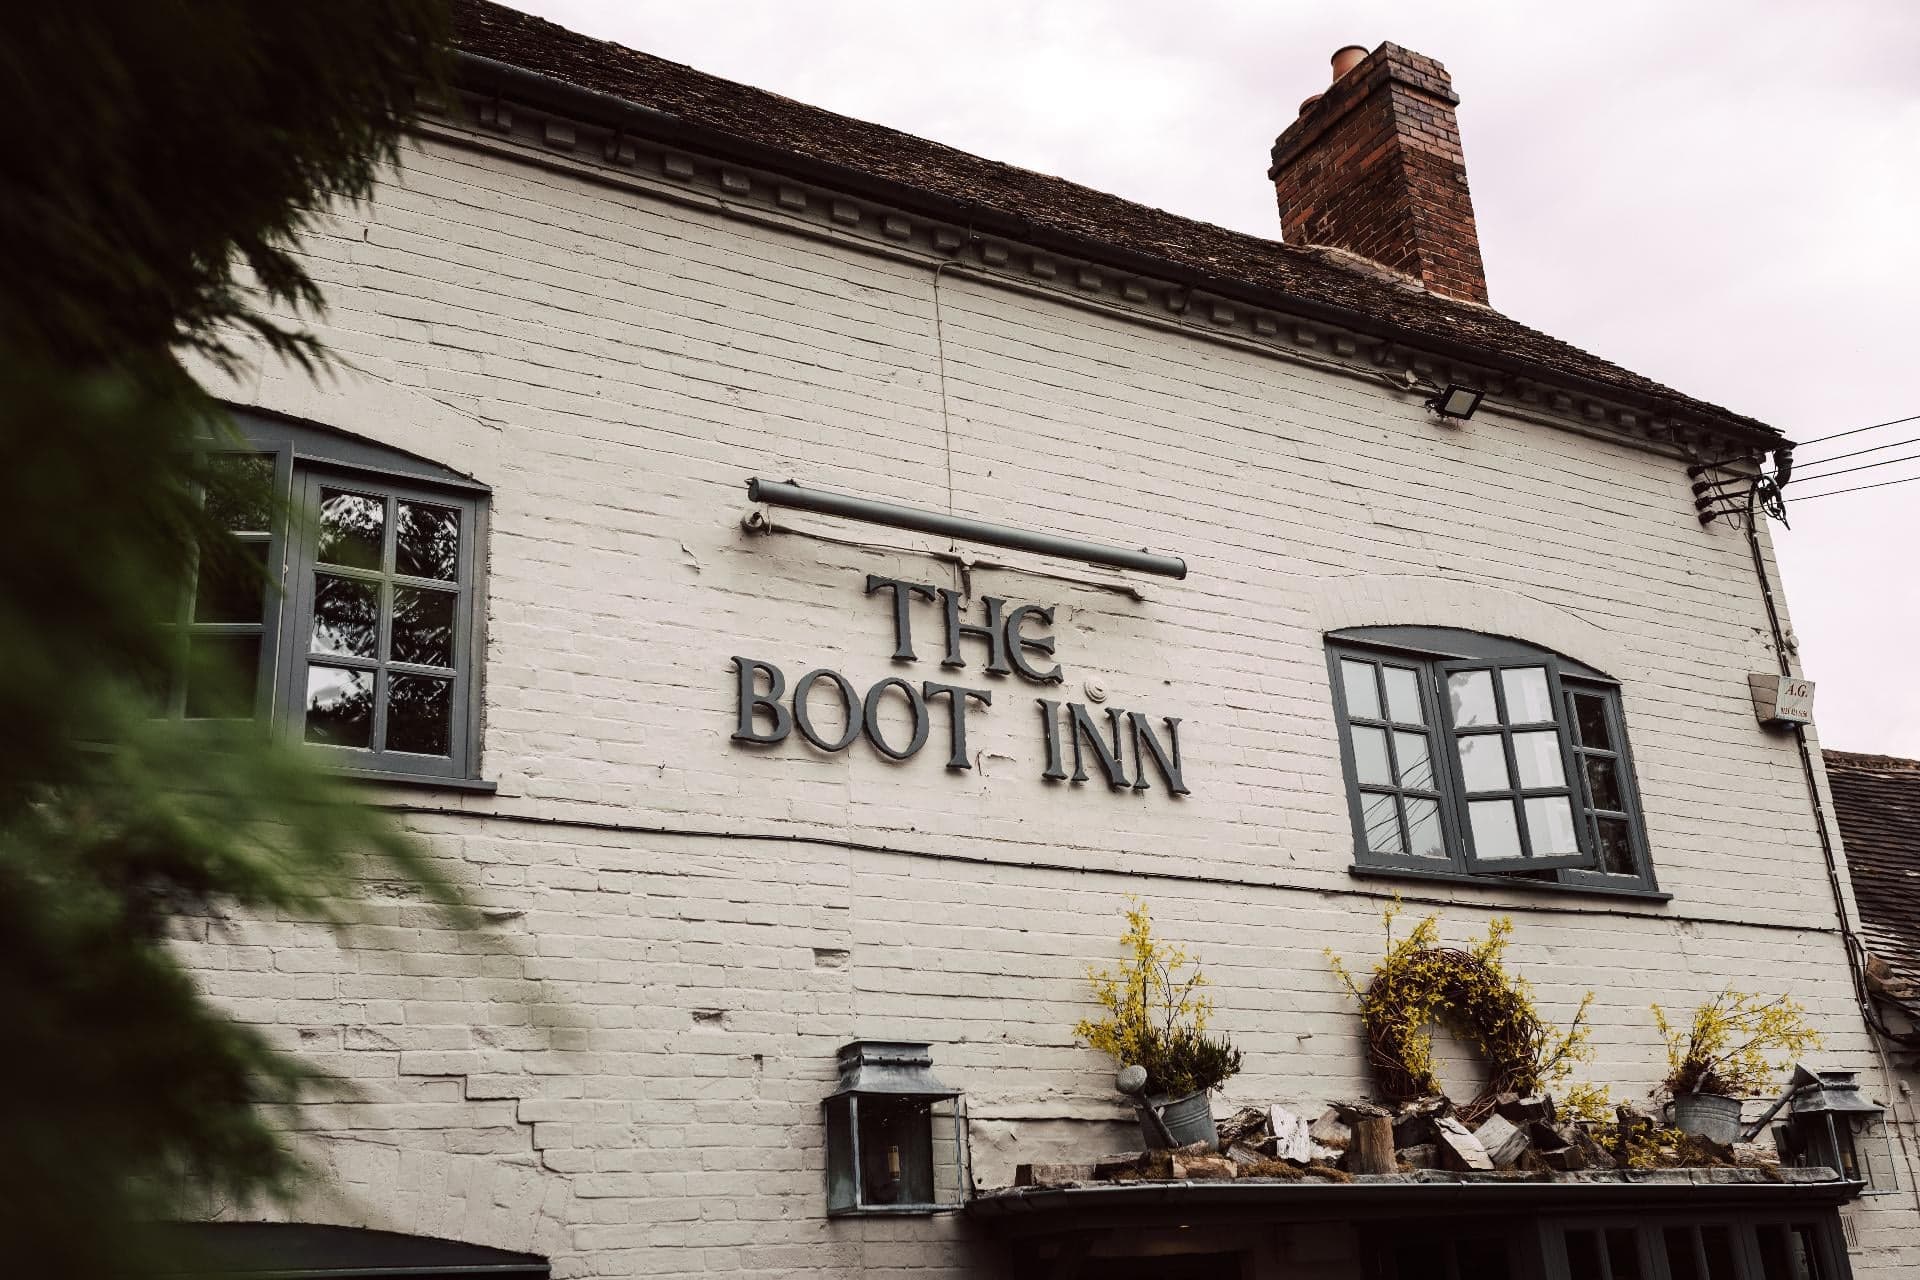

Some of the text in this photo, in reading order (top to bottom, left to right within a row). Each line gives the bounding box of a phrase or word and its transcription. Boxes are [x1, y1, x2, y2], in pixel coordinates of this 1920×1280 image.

[866, 574, 1063, 684] THE
[731, 656, 1191, 795] BOOT INN
